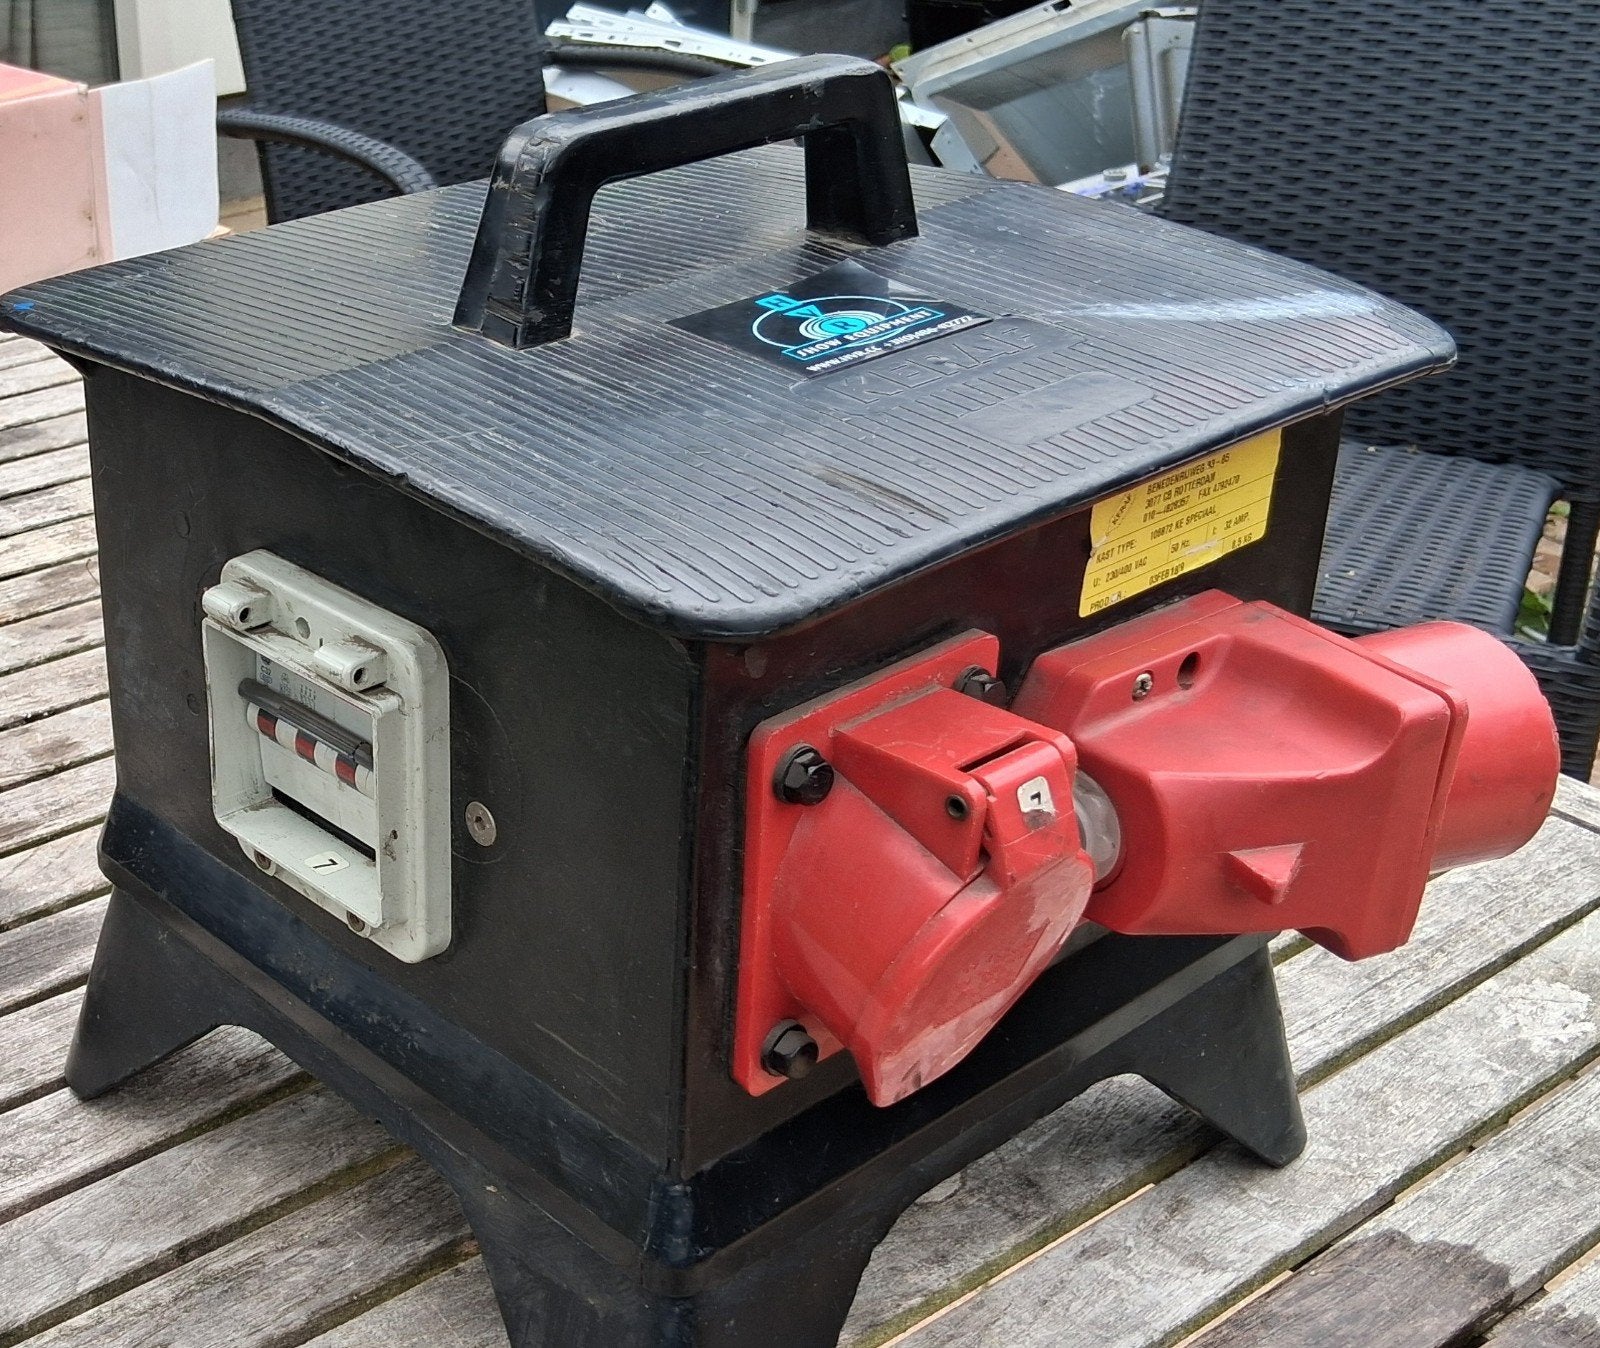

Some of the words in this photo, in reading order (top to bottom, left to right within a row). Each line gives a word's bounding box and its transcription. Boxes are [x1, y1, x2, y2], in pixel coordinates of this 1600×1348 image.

[796, 339, 842, 357] SHOW
[843, 310, 932, 341] EQUIPMENT
[1174, 472, 1216, 498] ROTTERDAM
[1198, 486, 1211, 500] FAX
[1096, 547, 1115, 564] KAST
[1134, 556, 1147, 569] VAC
